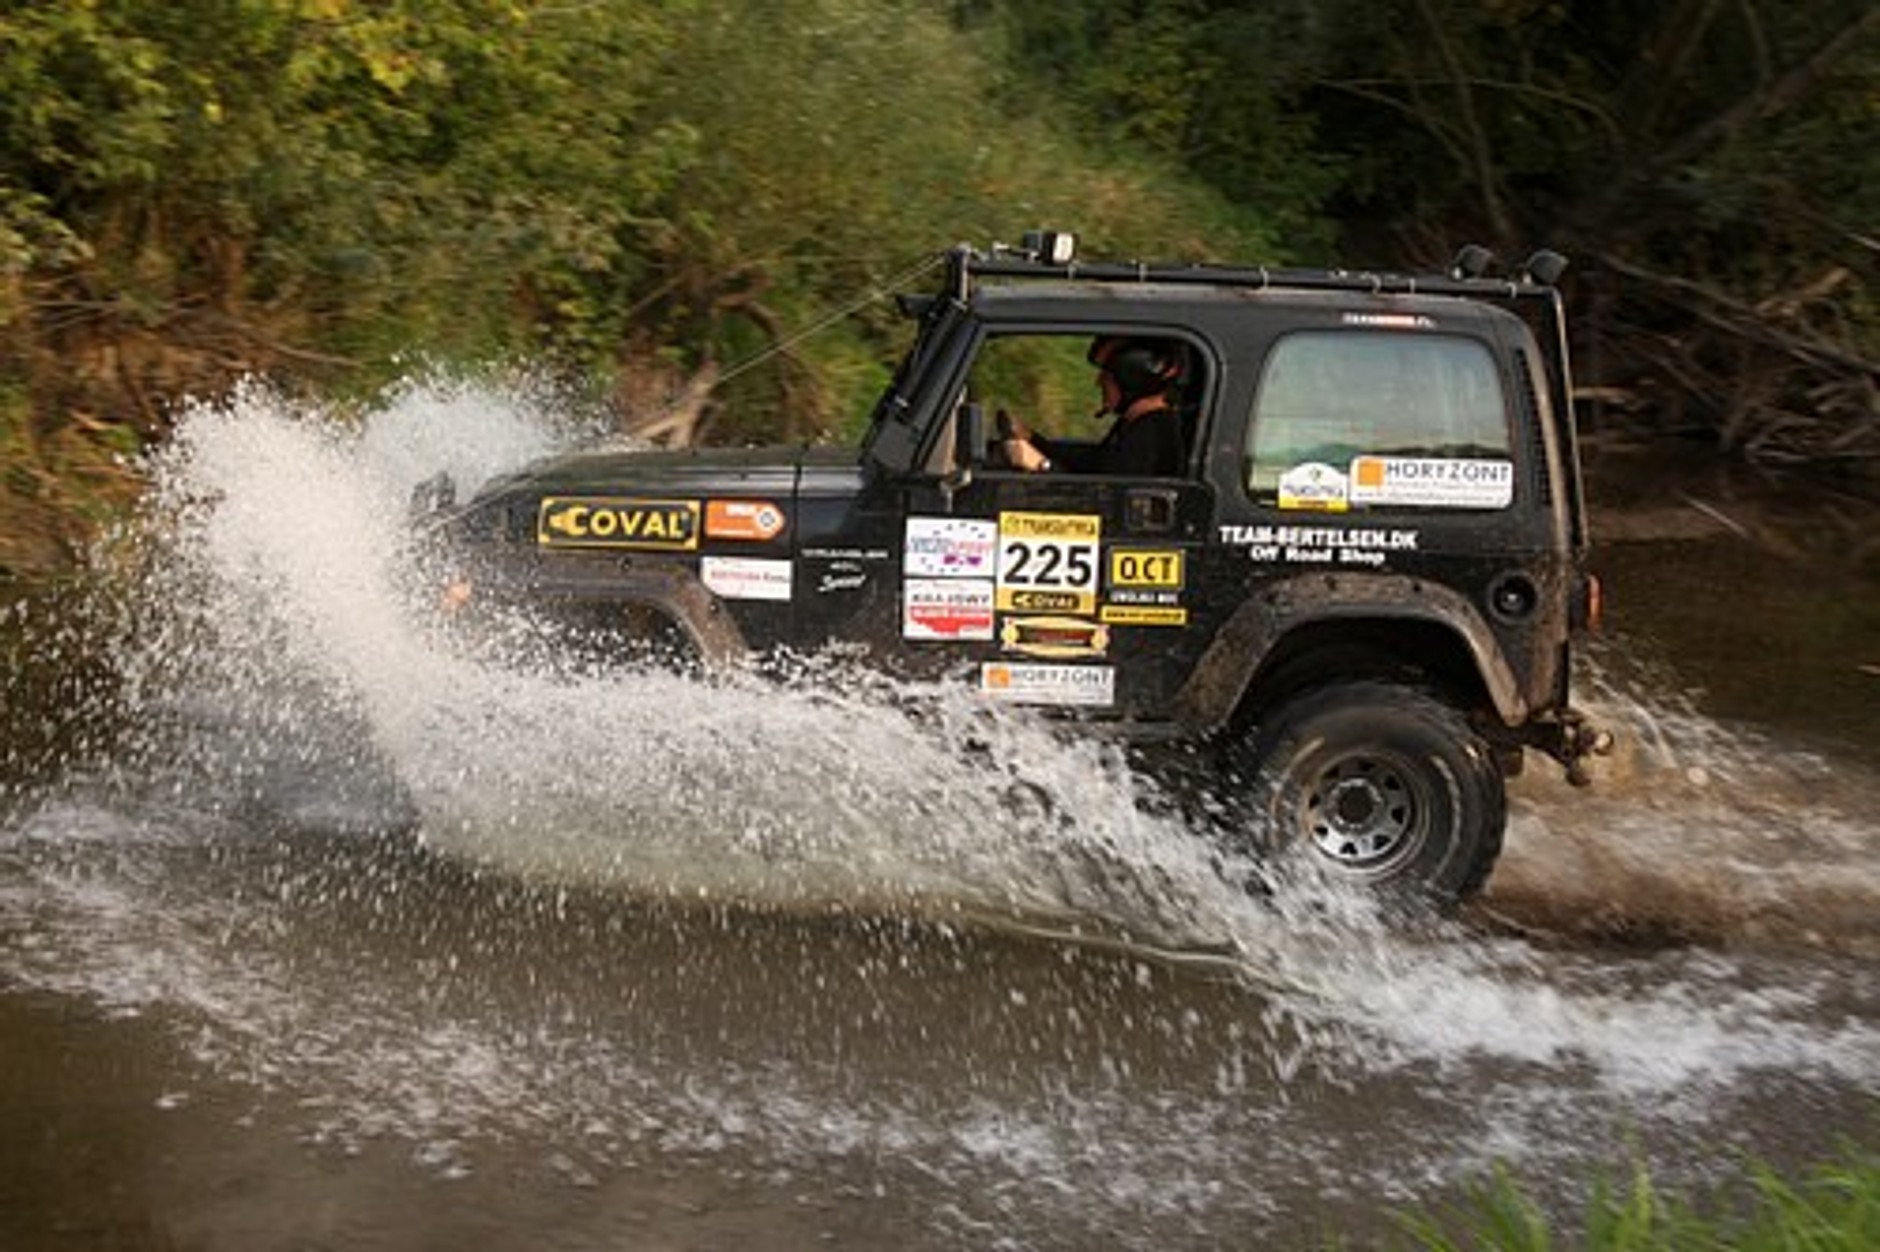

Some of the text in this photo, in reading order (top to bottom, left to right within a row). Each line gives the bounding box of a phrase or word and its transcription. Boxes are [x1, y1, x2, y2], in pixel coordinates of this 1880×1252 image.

[1386, 461, 1510, 482] HORYZONT
[551, 504, 684, 538] COVAL
[1003, 541, 1092, 588] 225
[1249, 546, 1386, 566] Off Road Shop
